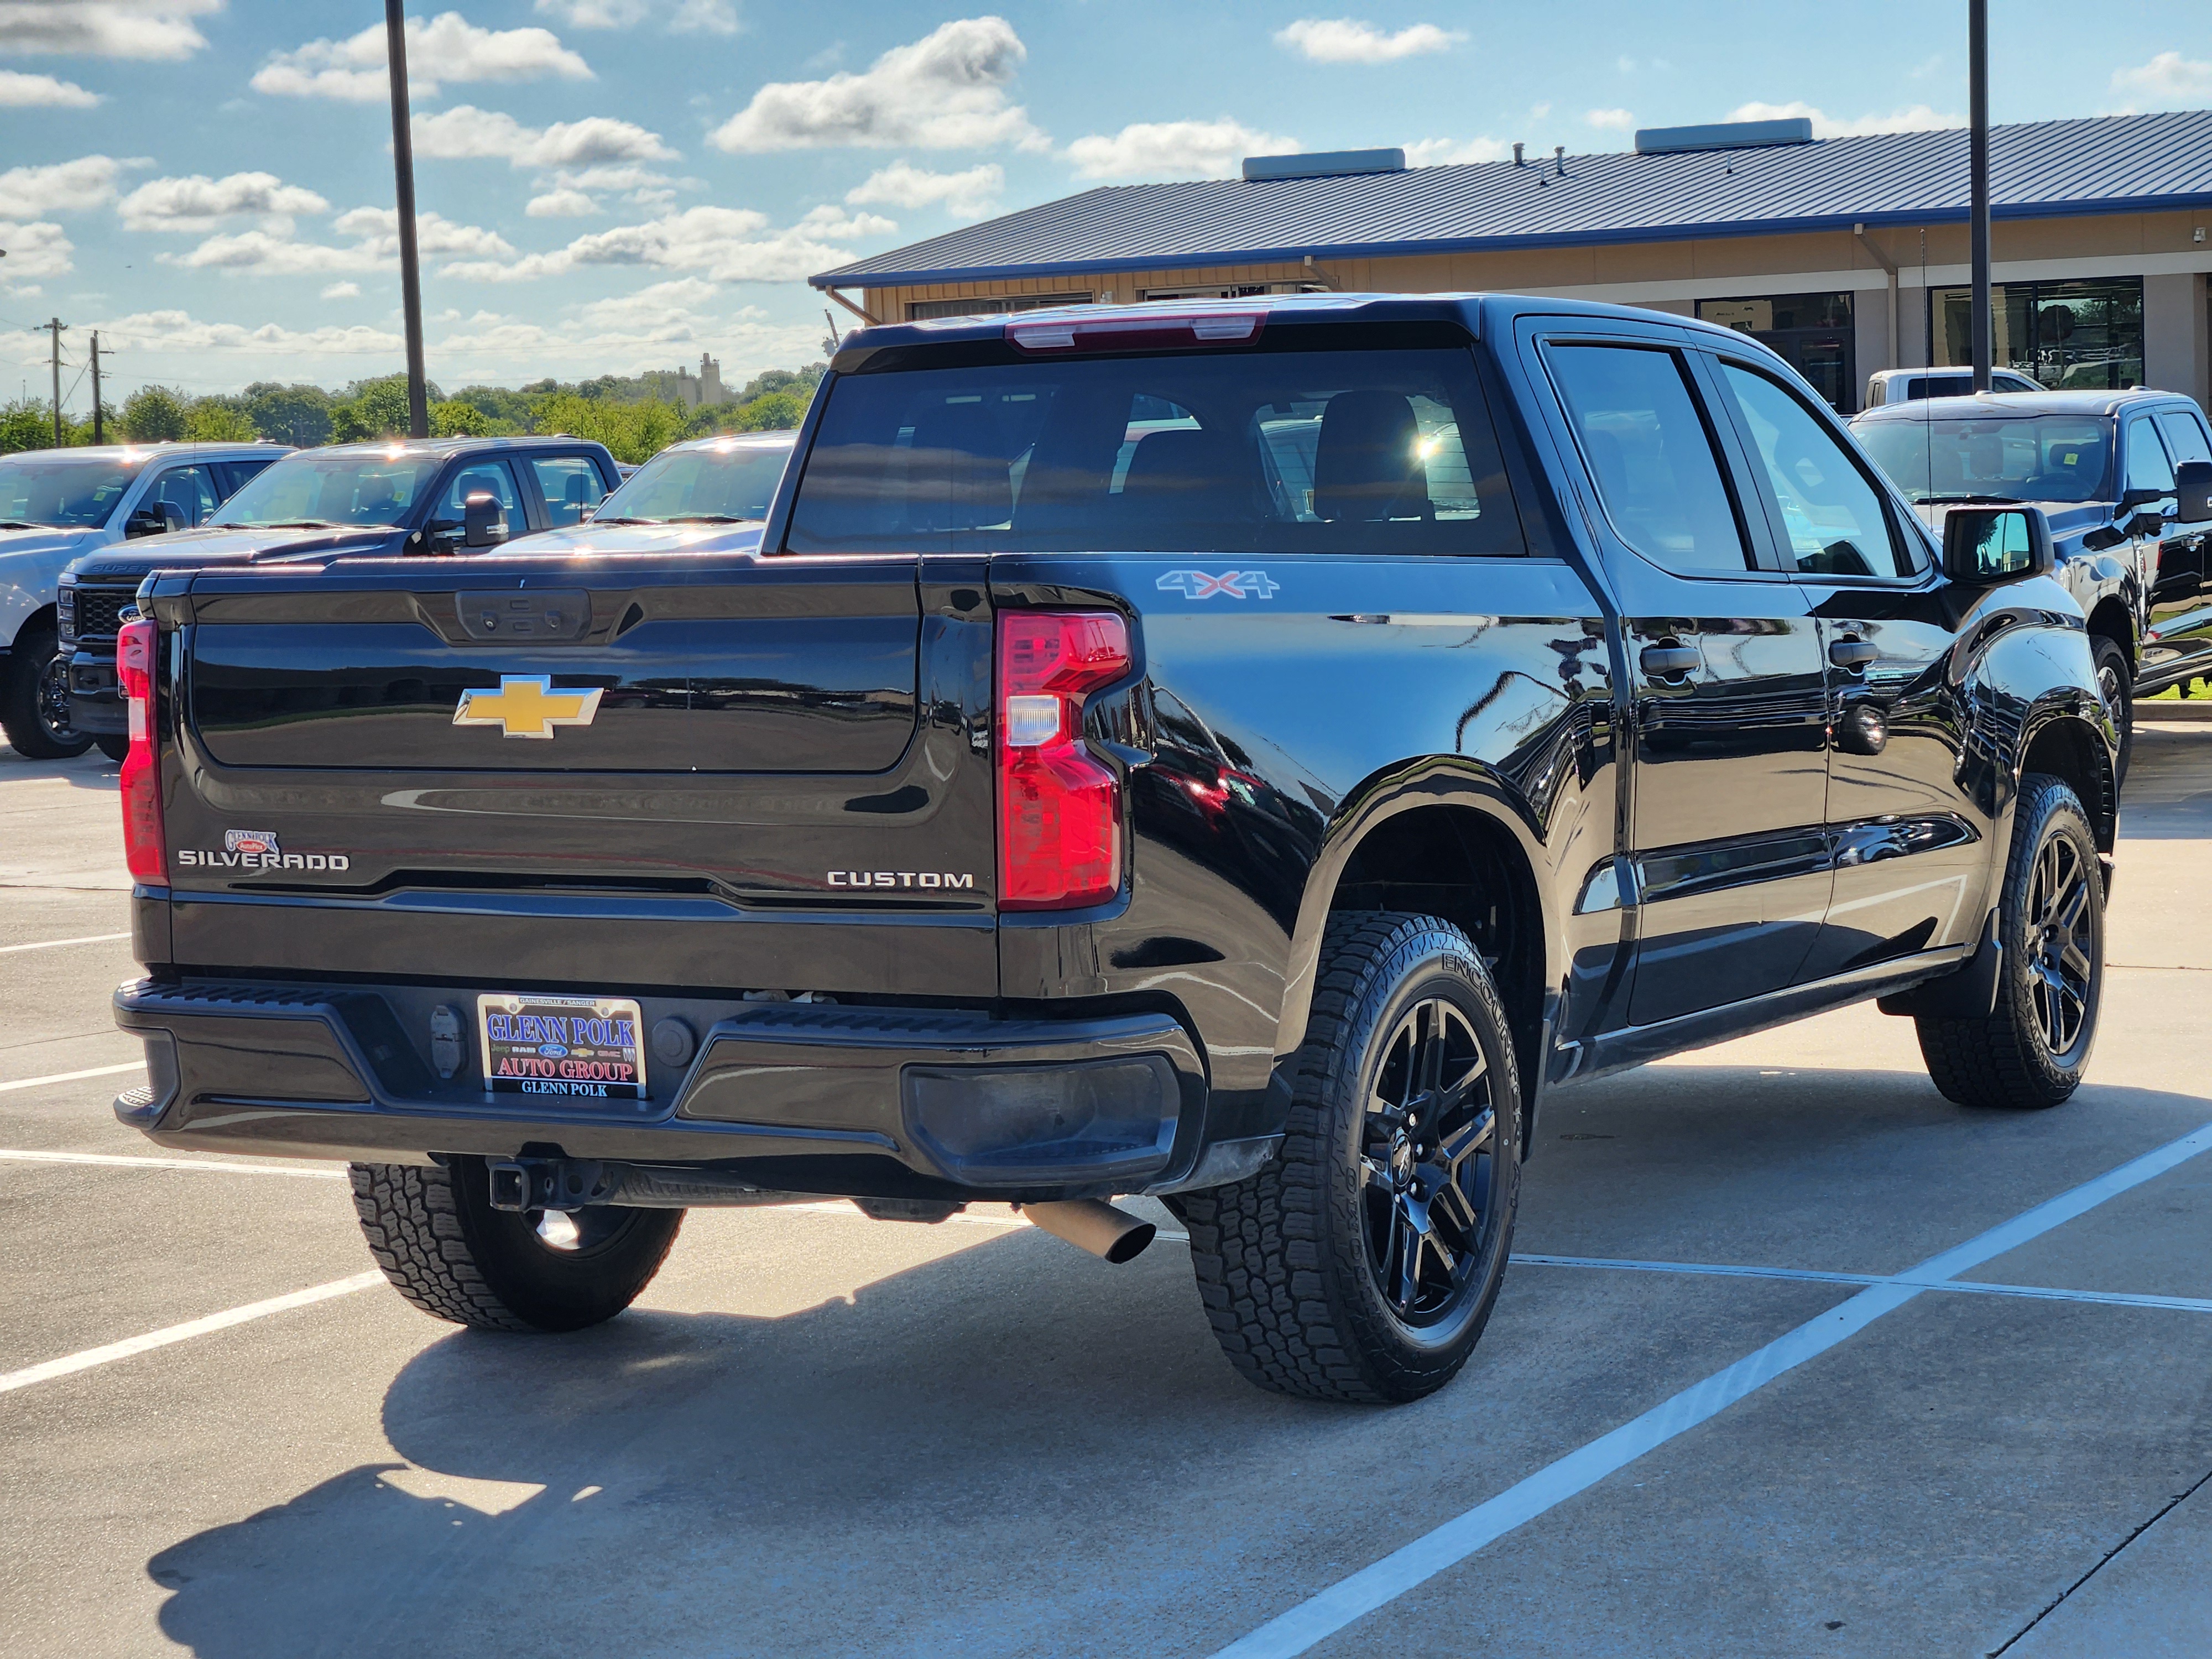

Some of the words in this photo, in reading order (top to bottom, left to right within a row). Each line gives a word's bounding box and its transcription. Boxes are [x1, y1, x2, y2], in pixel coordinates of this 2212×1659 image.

[91, 564, 153, 572] SUPER
[178, 850, 349, 870] SILVERADO
[827, 871, 973, 888] CUSTOM
[487, 1014, 567, 1044] GLENN
[571, 1018, 636, 1047] POLK
[491, 1044, 510, 1054] Jeep
[498, 1057, 555, 1076] AUTO
[560, 1060, 633, 1081] GROUP
[521, 1081, 568, 1094] GLENN
[571, 1083, 608, 1097] POLK
